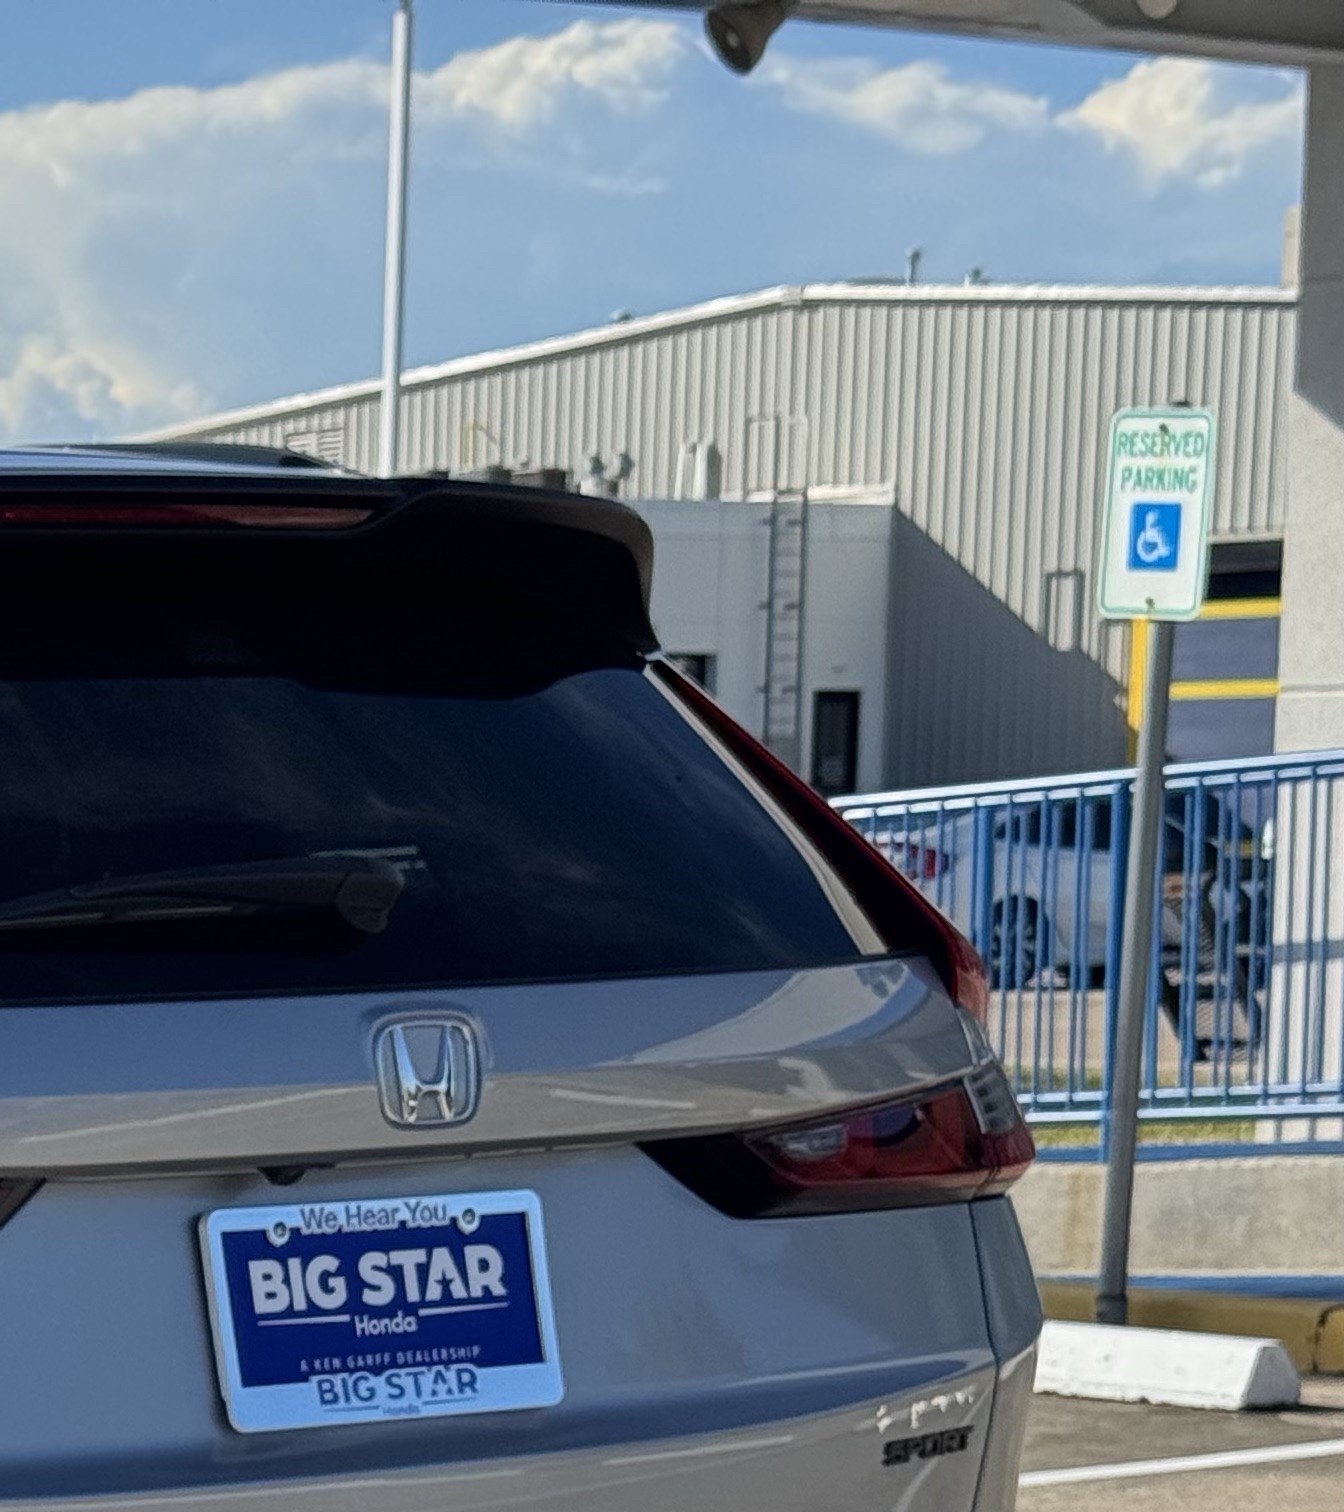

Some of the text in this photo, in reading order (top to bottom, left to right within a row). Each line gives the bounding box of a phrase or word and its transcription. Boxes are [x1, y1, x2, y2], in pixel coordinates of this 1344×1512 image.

[1116, 431, 1205, 458] RESERVED
[1120, 465, 1198, 494] PARKING
[300, 1201, 447, 1231] We Hear You
[247, 1244, 508, 1315] BIG STAR
[353, 1310, 419, 1338] Honda
[396, 1345, 481, 1365] DEALERSHIP
[316, 1367, 480, 1406] BIG STAR
[882, 1424, 975, 1467] SPORT
